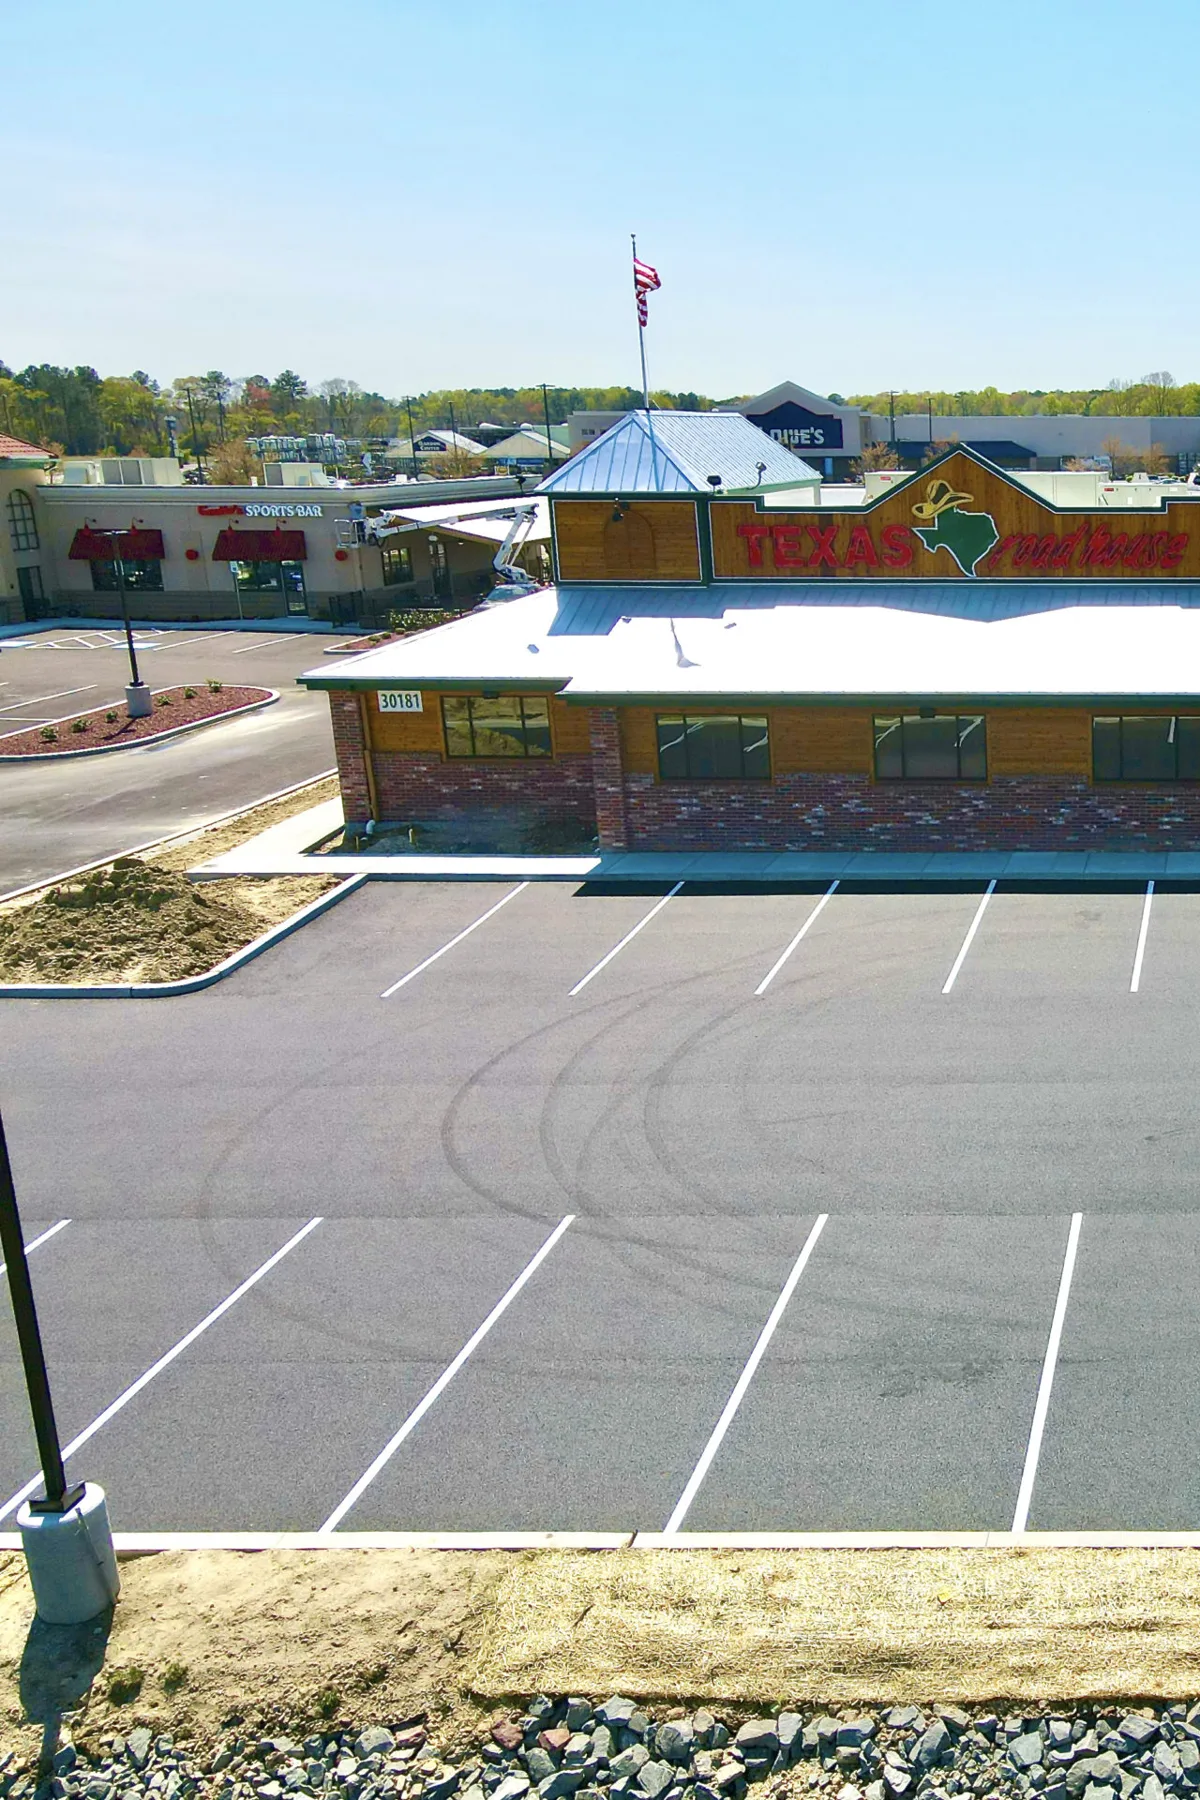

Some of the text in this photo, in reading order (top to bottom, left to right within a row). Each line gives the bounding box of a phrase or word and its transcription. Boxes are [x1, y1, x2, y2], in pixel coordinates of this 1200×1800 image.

[245, 504, 294, 517] SPORTS
[296, 504, 323, 517] BAR
[737, 524, 914, 569] TEXAS
[381, 693, 420, 709] 30181
